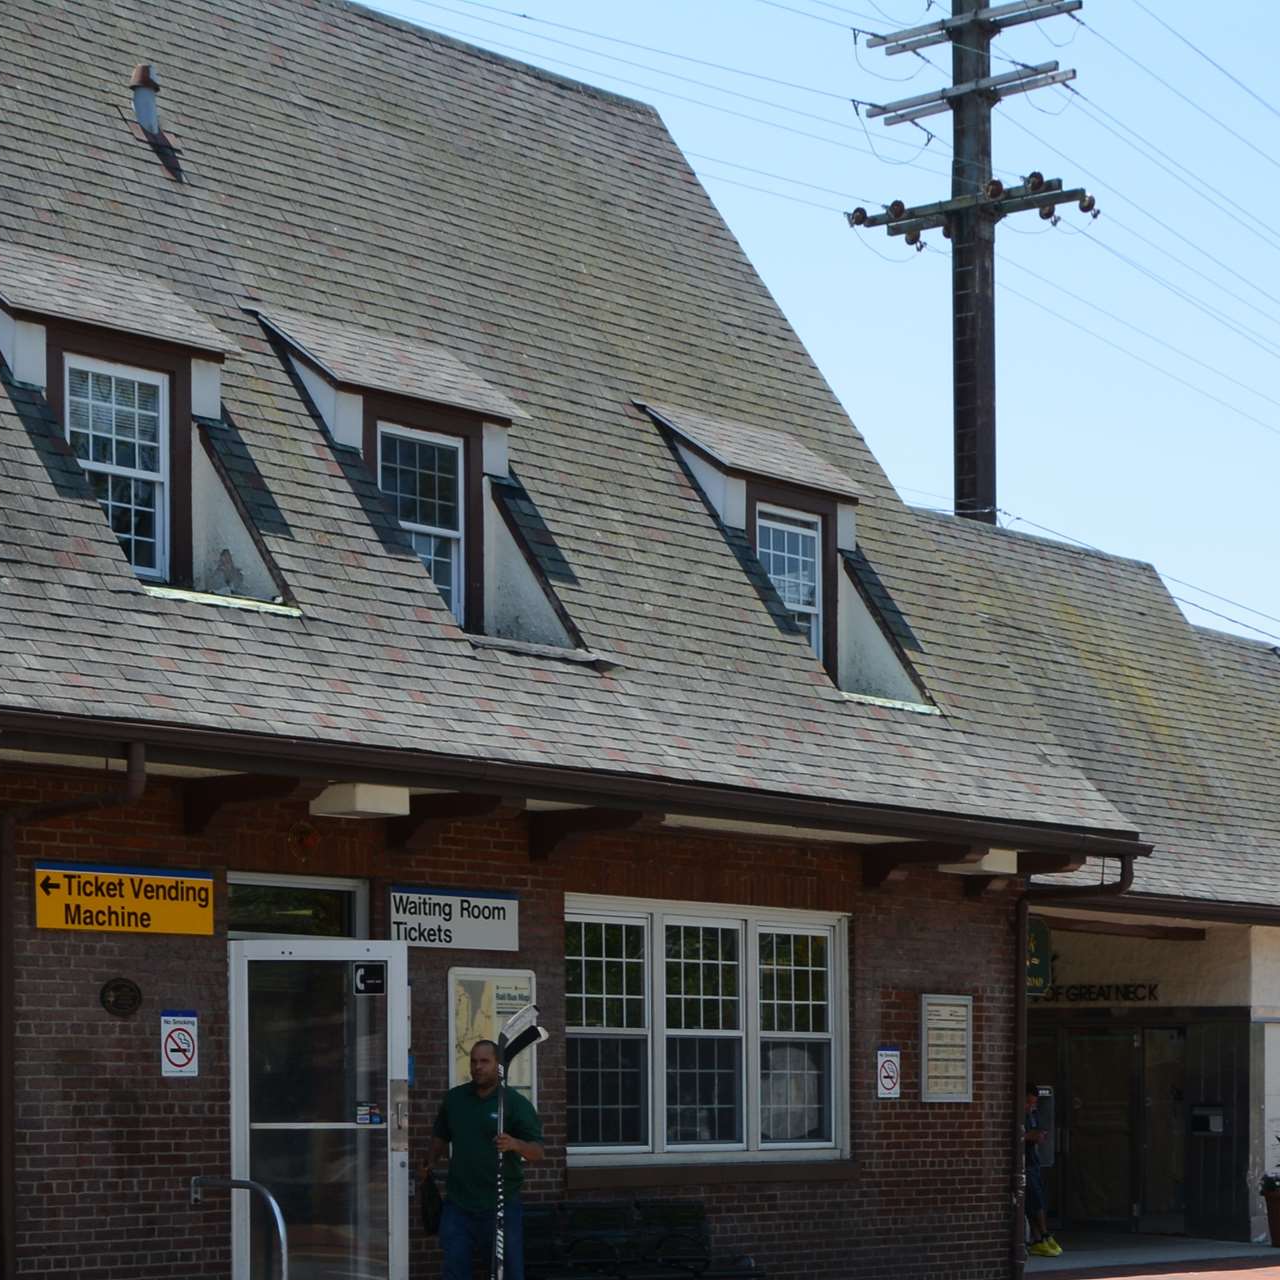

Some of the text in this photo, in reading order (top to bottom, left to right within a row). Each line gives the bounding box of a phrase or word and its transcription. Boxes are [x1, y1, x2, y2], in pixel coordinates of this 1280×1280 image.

[63, 874, 209, 908] Ticket Vending
[64, 903, 151, 928] Machine
[392, 894, 506, 922] Waiting Room
[392, 921, 453, 943] Tickets
[1065, 984, 1113, 1001] GREAT
[1115, 984, 1159, 1001] NECK
